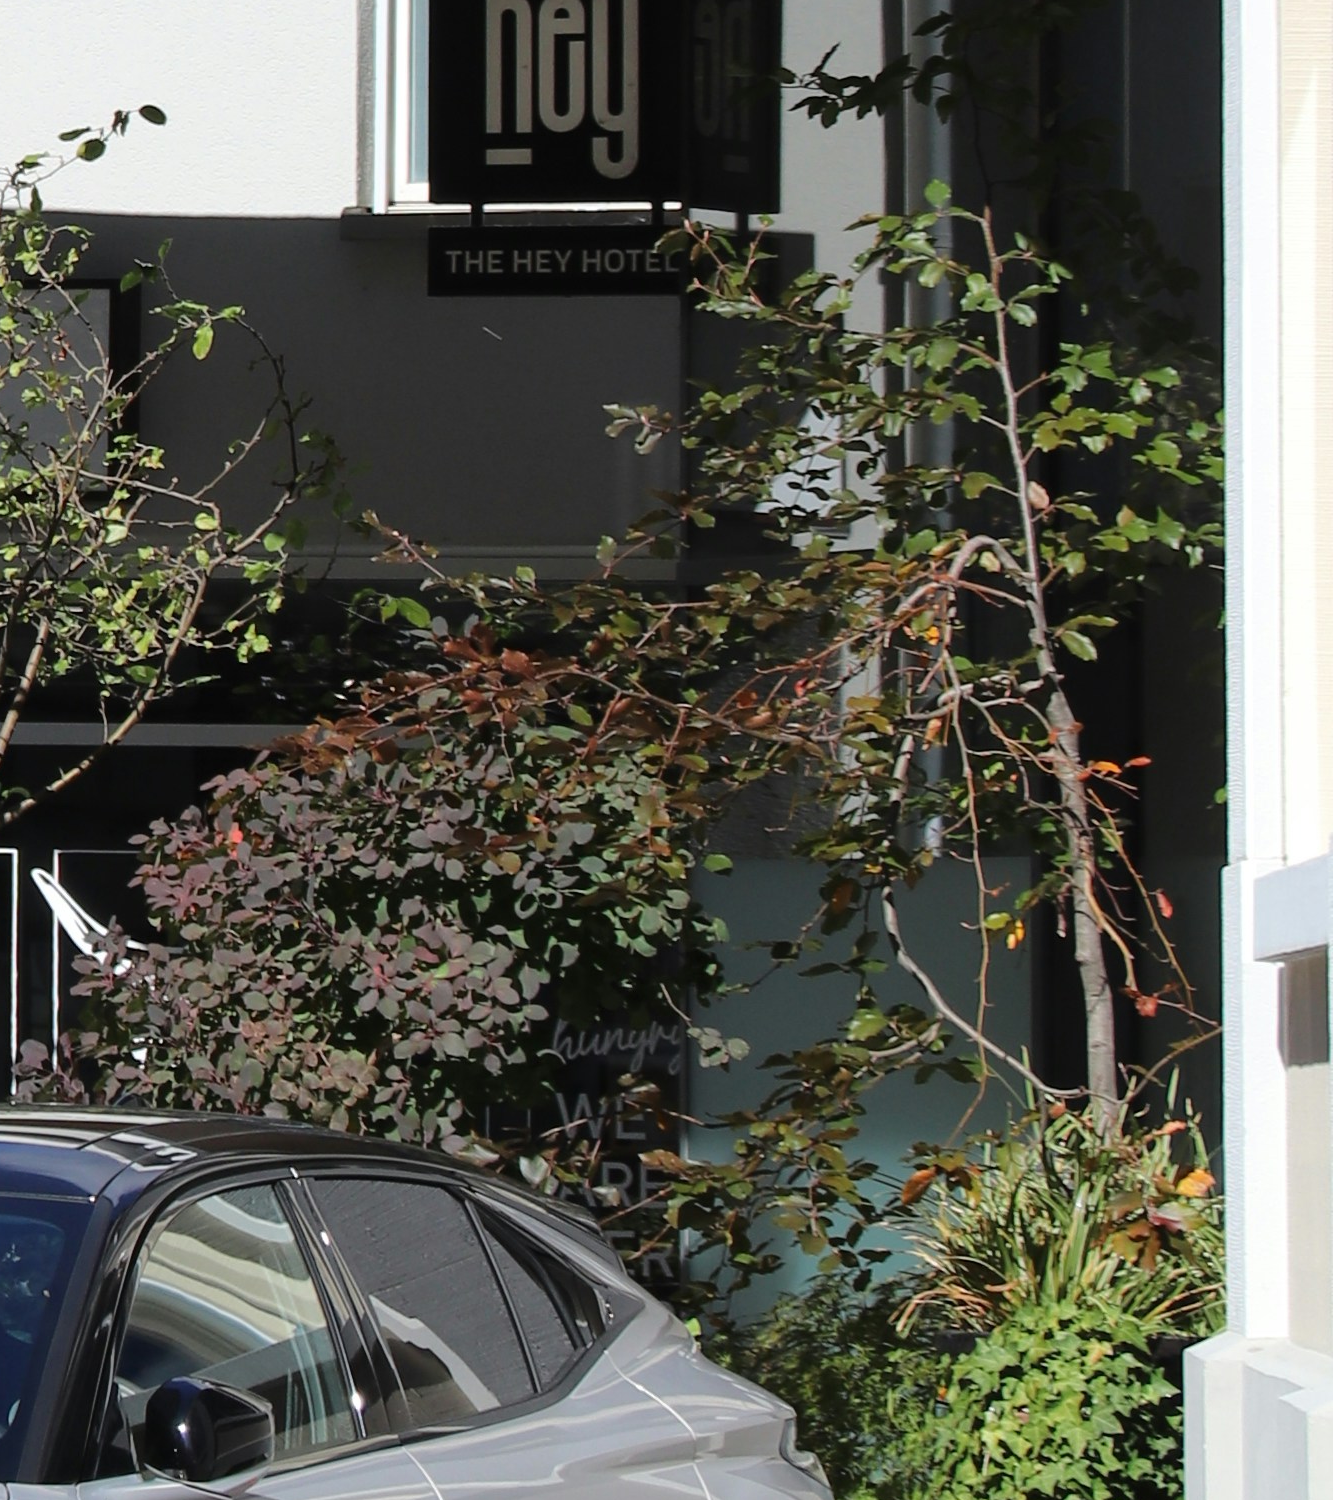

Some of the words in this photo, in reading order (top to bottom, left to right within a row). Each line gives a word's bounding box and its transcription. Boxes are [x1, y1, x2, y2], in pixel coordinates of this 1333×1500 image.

[445, 250, 504, 274] THE
[513, 250, 573, 273] HEY
[581, 249, 680, 274] HOTEL
